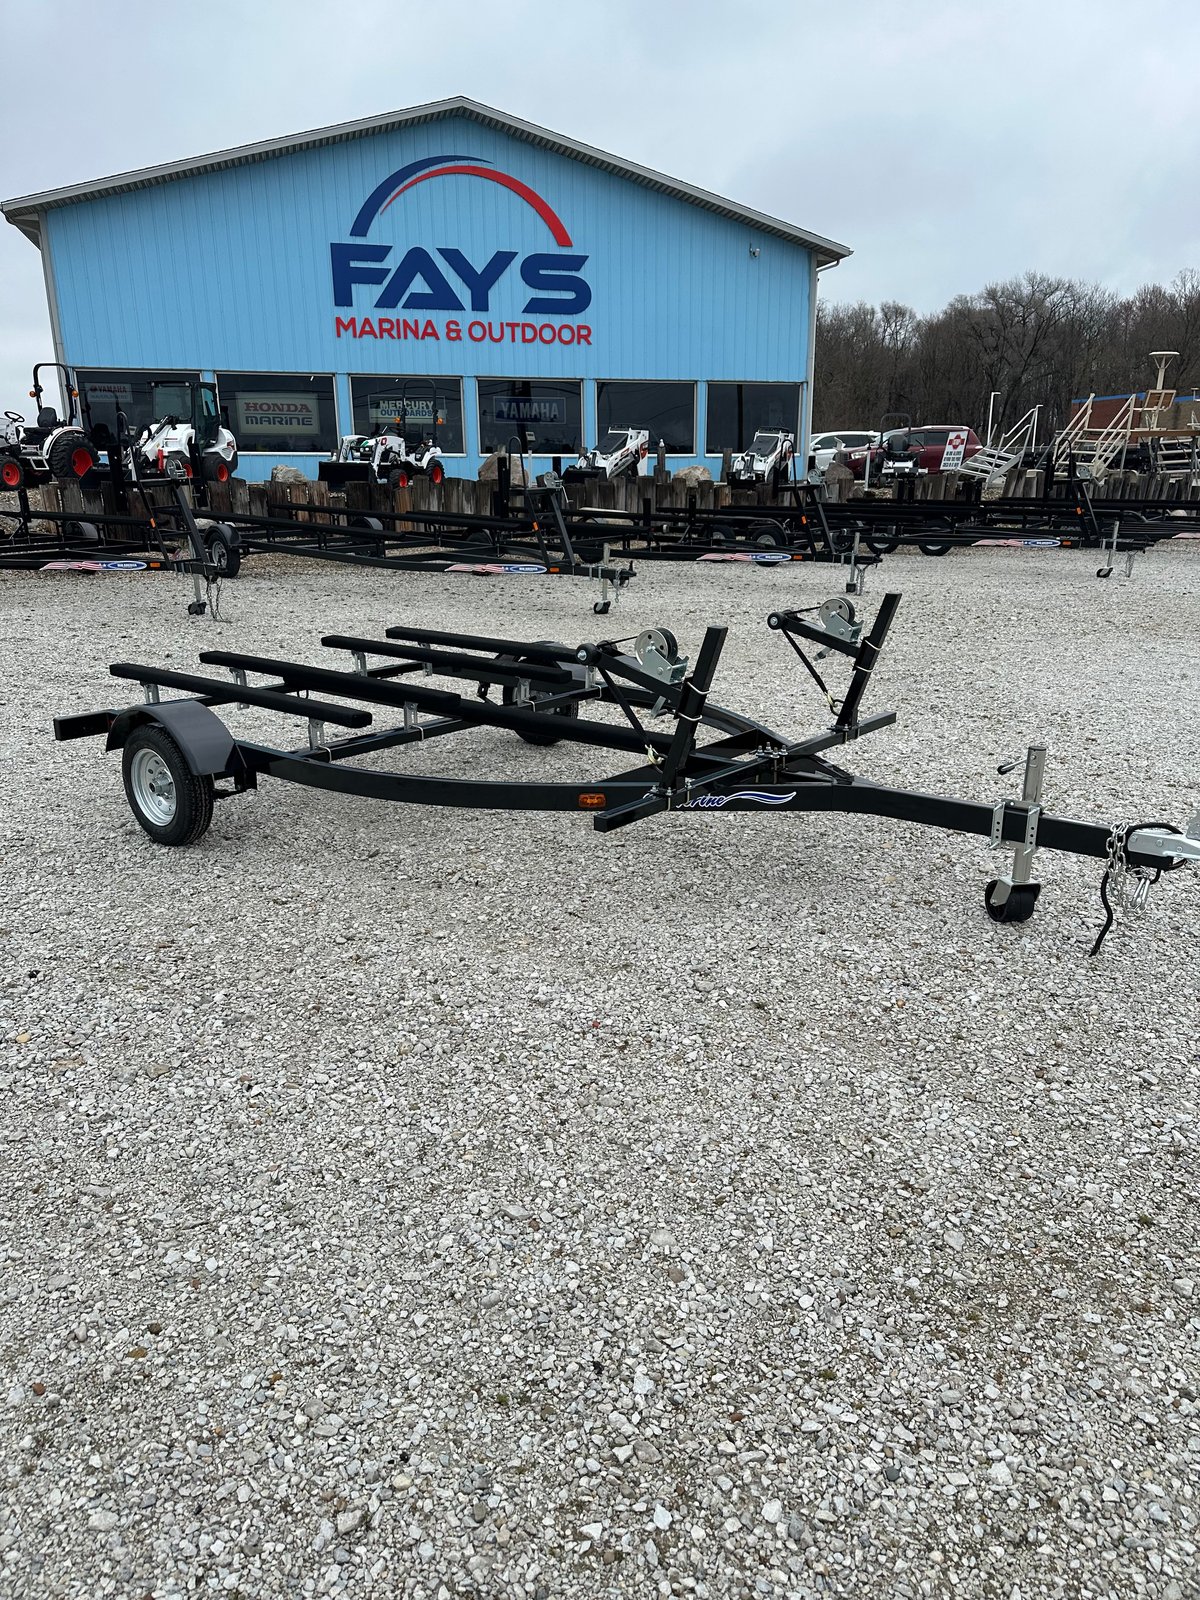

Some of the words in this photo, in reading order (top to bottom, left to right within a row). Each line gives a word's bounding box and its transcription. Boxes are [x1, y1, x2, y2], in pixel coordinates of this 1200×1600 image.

[330, 242, 592, 315] FAYS
[335, 316, 440, 341] MARINA
[446, 320, 462, 342] &
[468, 321, 592, 346] OUTDOOR
[98, 385, 127, 393] YAMAHA
[244, 402, 312, 413] HONDA
[380, 400, 434, 410] MERCURY
[500, 402, 560, 419] YAMAHA
